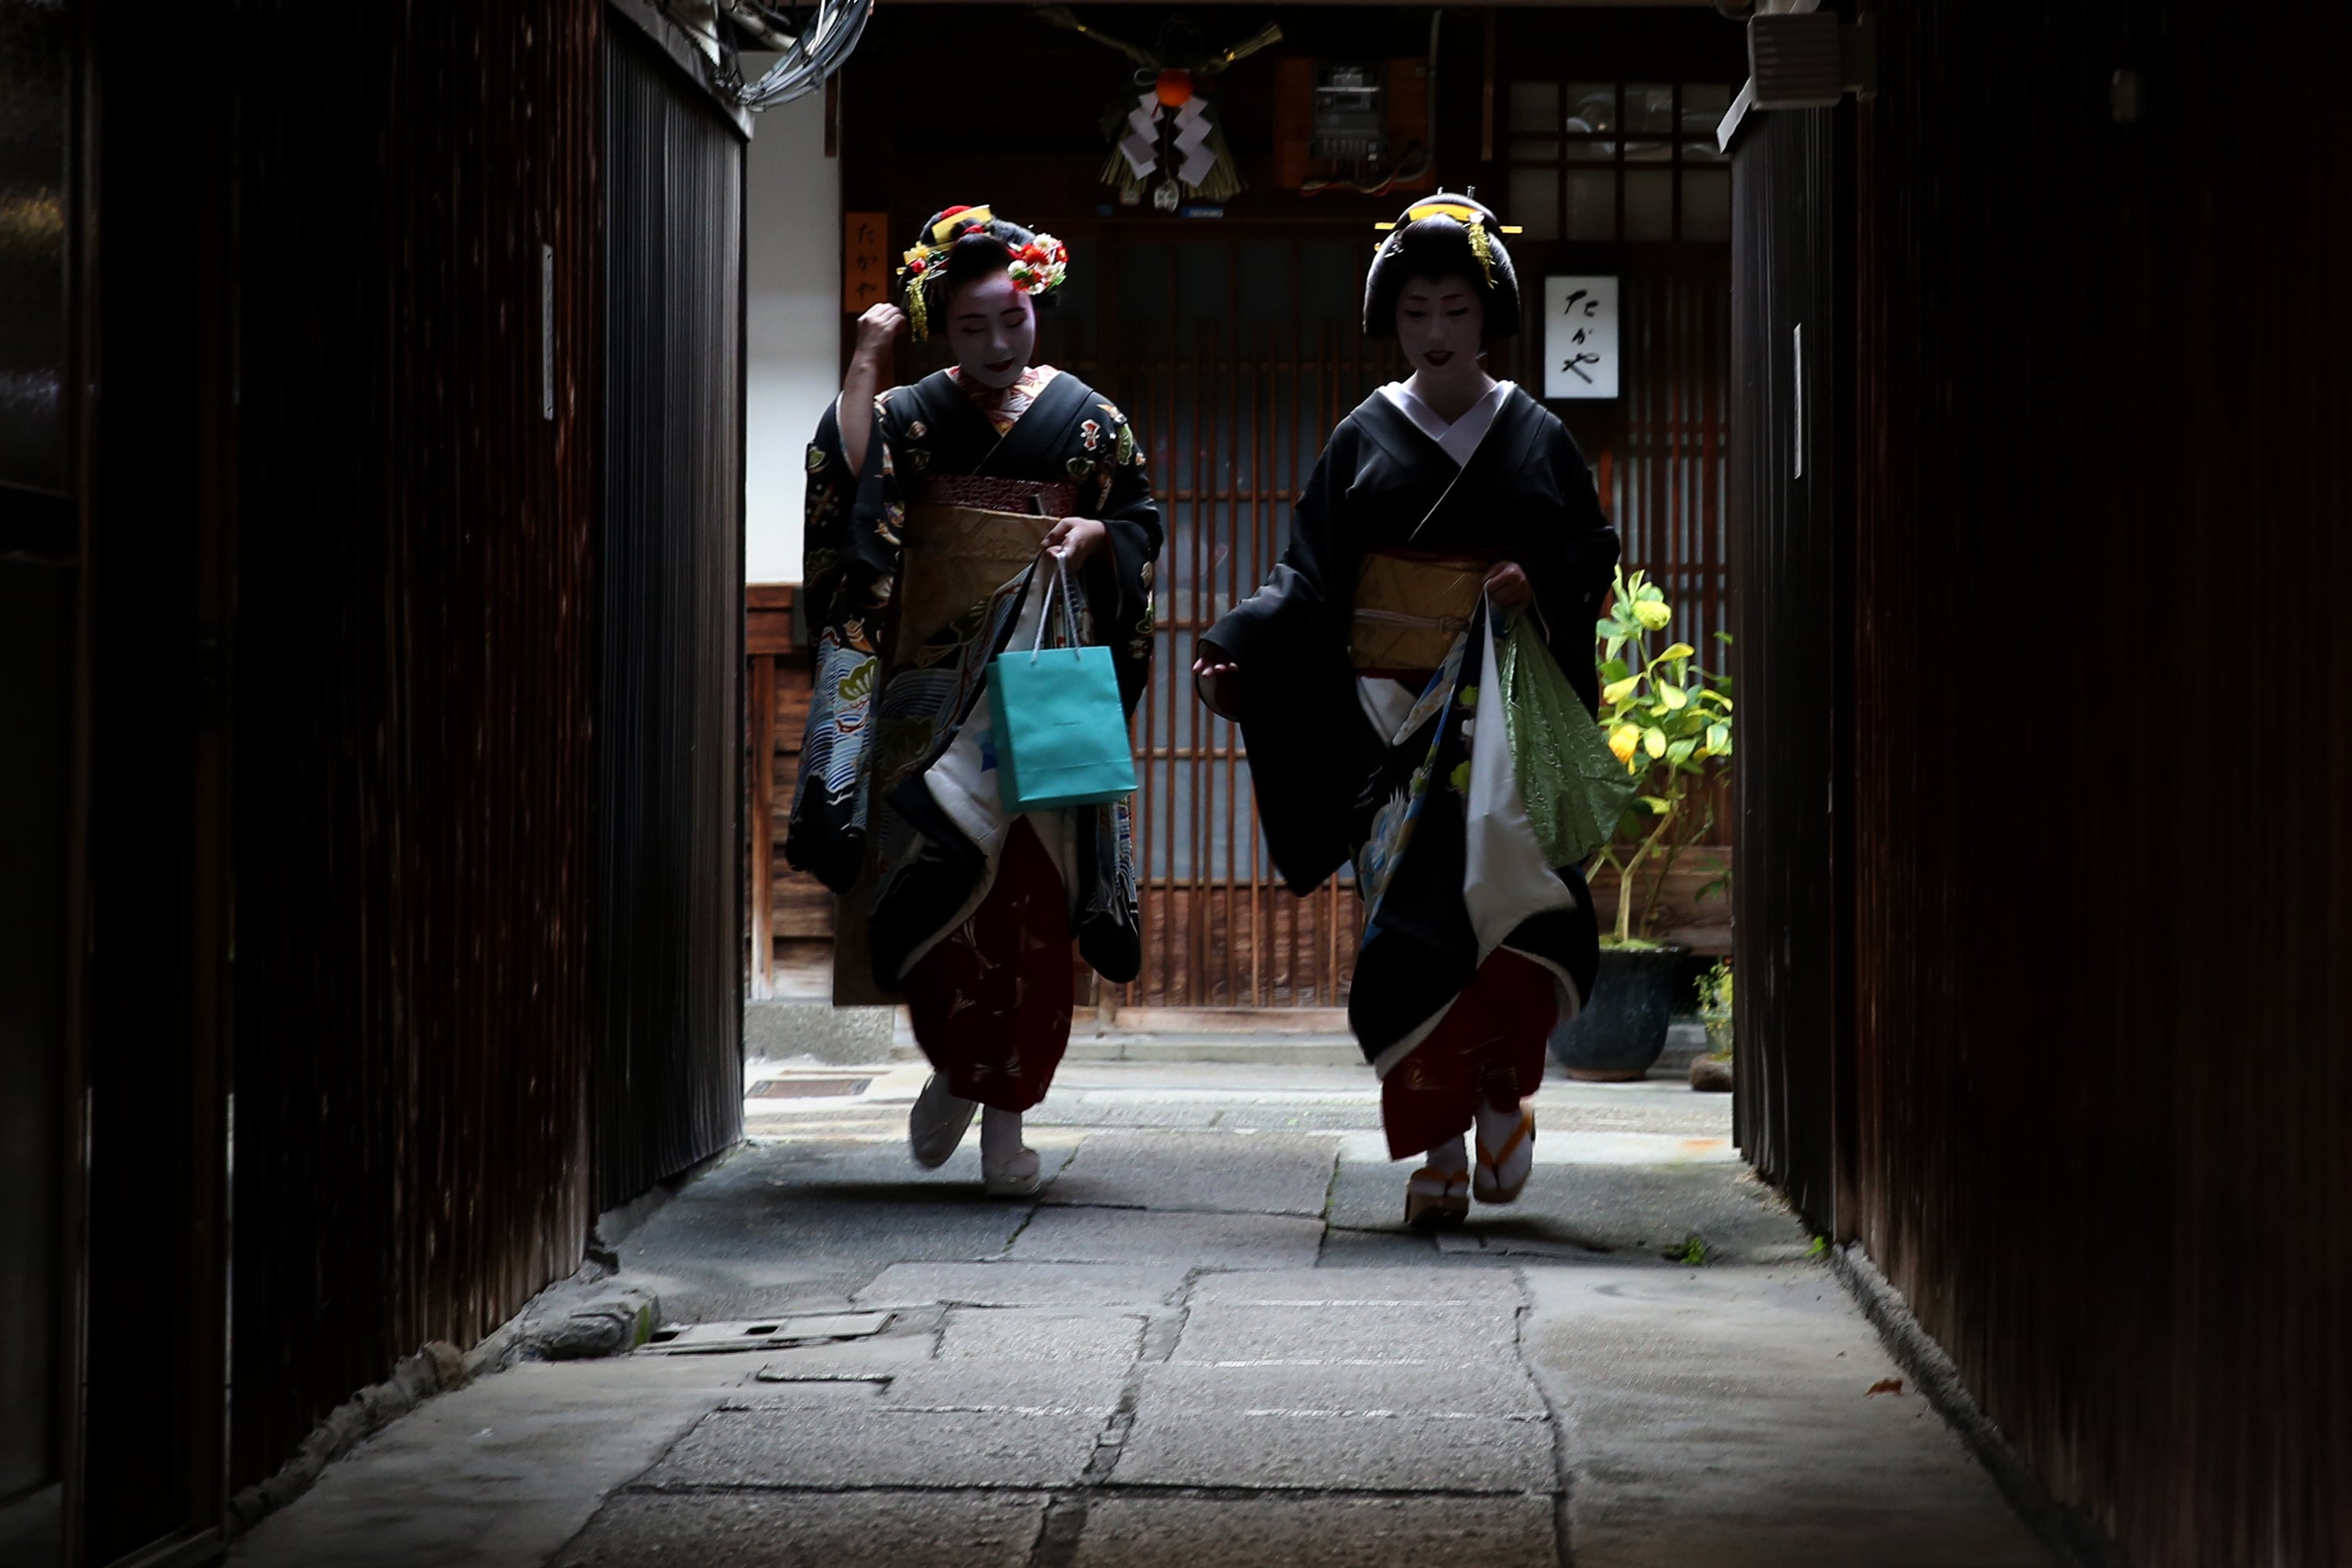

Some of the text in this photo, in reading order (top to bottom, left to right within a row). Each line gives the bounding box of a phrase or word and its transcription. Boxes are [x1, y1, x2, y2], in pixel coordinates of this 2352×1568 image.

[856, 223, 877, 299] たかや
[1562, 289, 1599, 384] たかや
